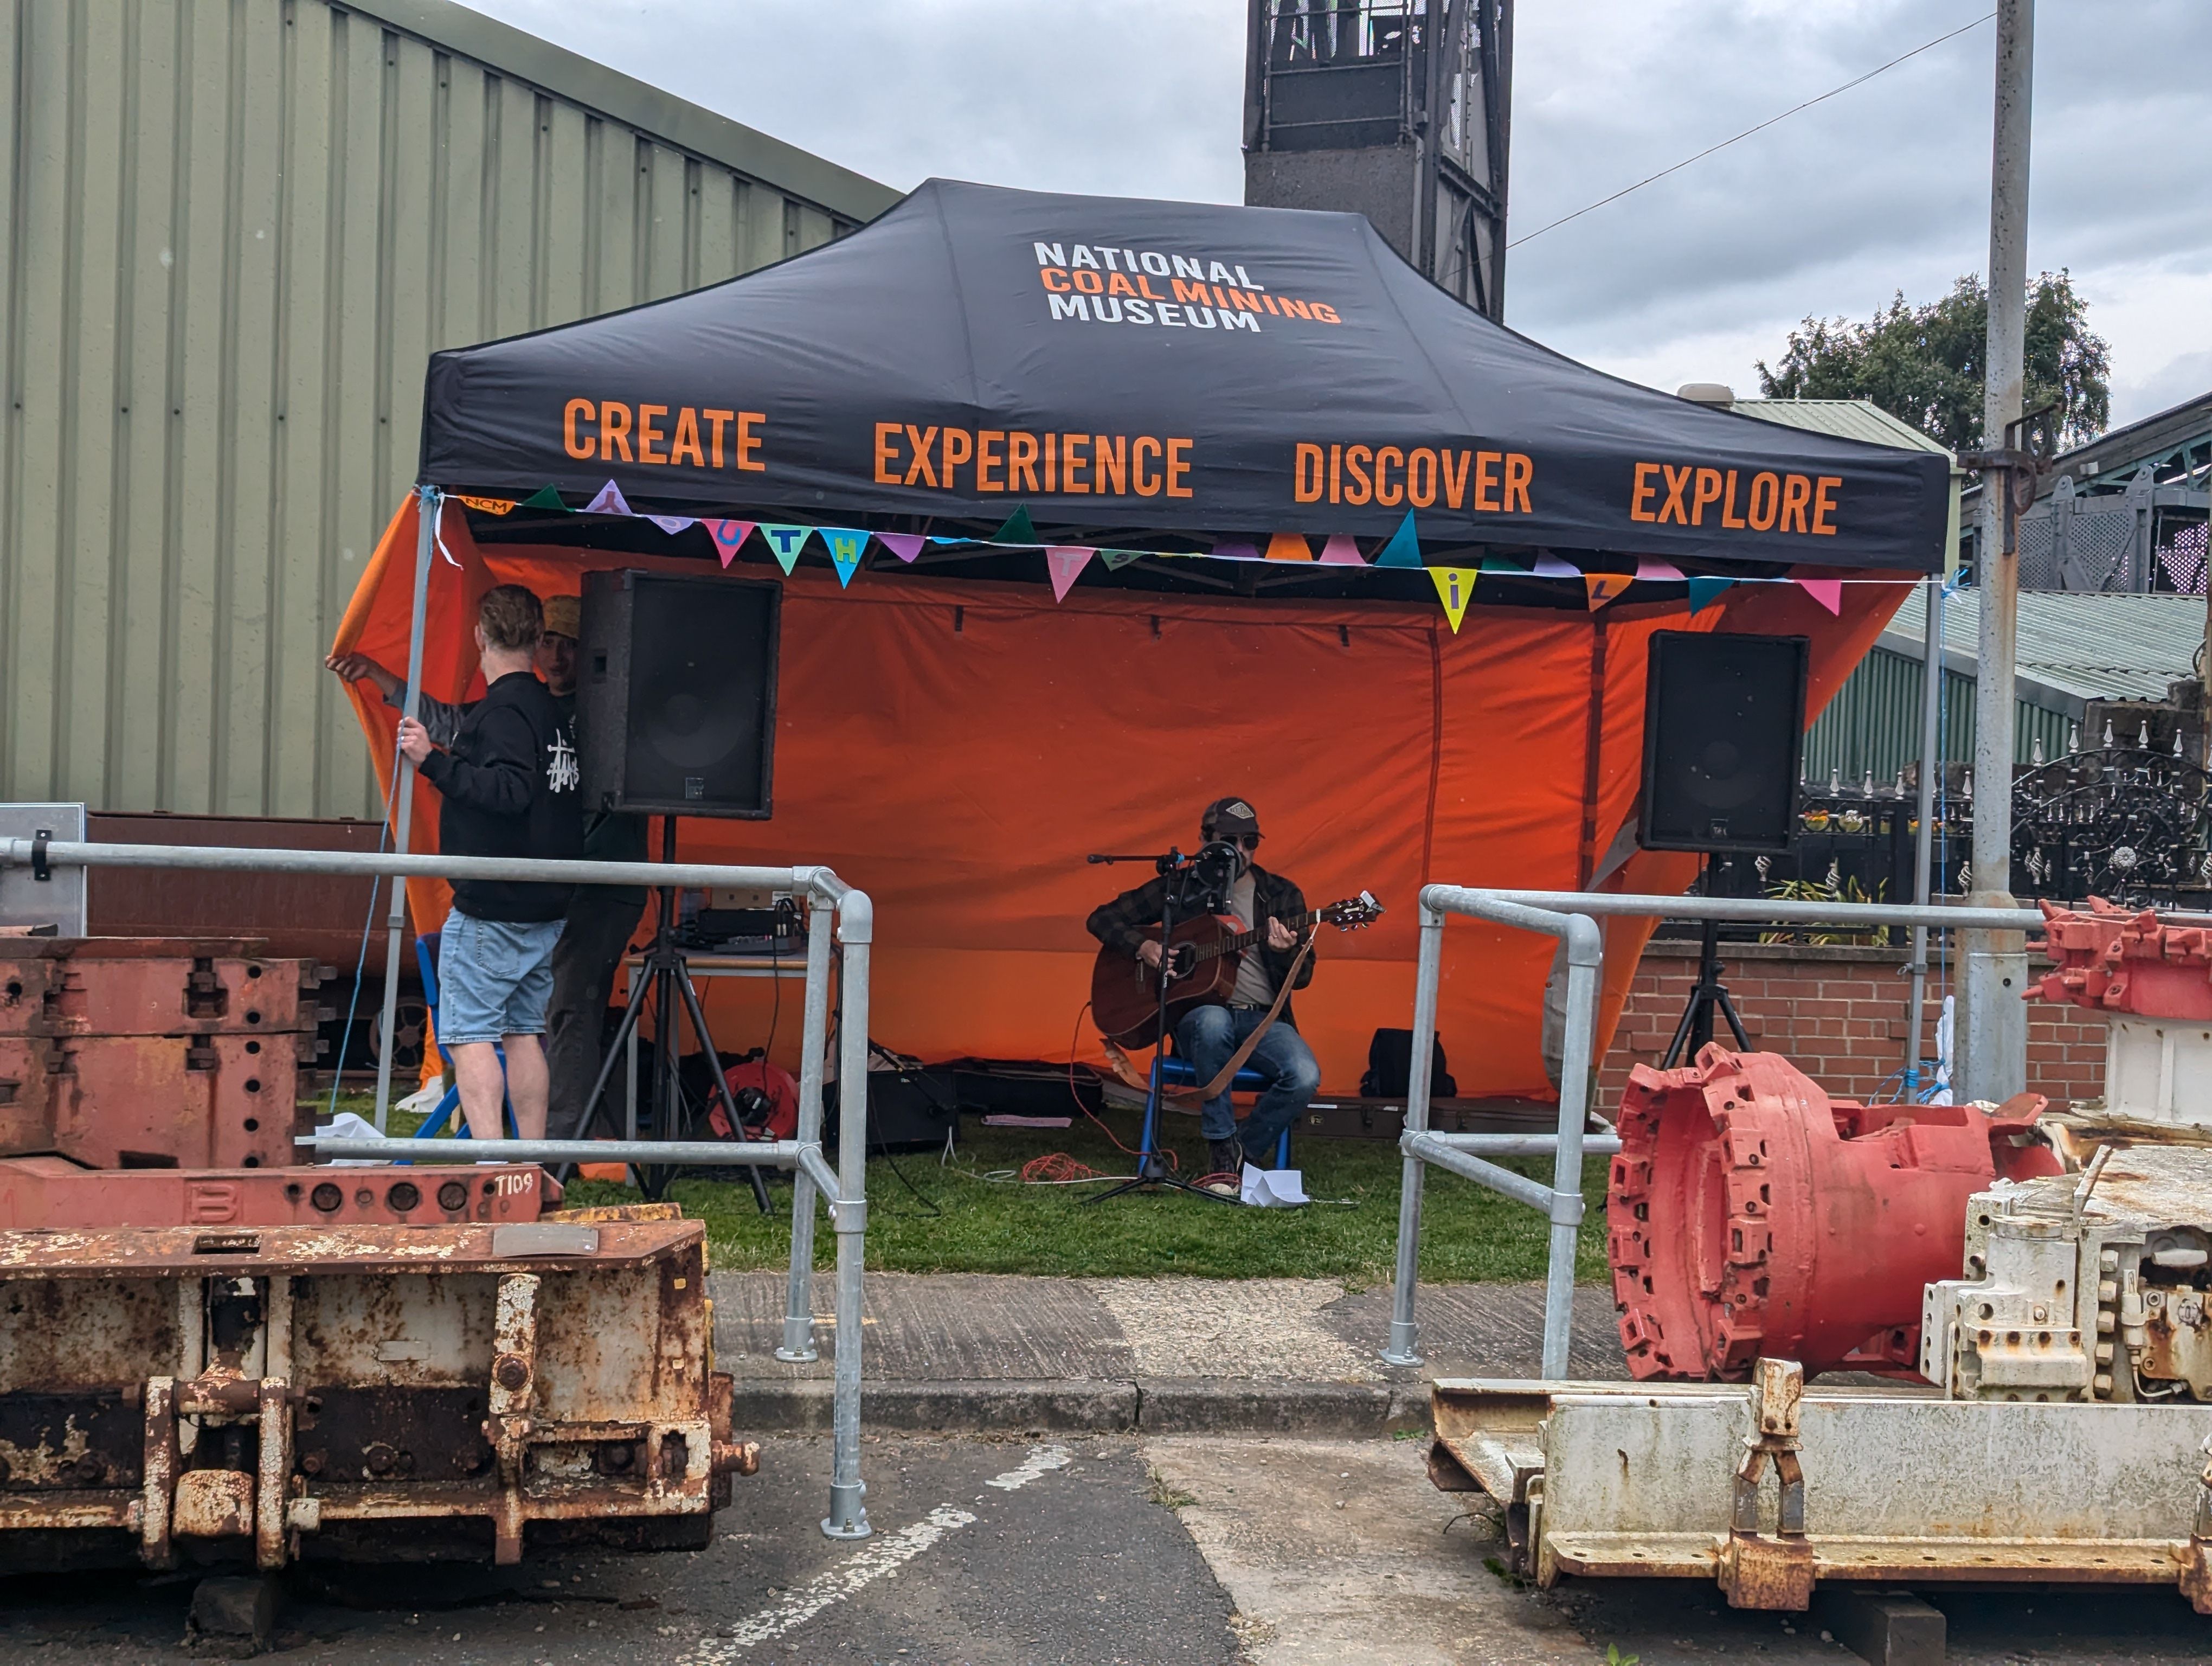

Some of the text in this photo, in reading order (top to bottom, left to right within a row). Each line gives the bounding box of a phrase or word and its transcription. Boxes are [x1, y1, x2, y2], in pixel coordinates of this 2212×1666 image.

[1033, 242, 1264, 291] NATIONAL
[1040, 268, 1341, 324] COAL MINING
[1047, 294, 1261, 332] MUSEUM
[564, 398, 1842, 535] CREATE EXPERIENCE DISCOVER EXPLORE
[465, 497, 508, 513] NCM
[495, 1172, 533, 1196] T109
